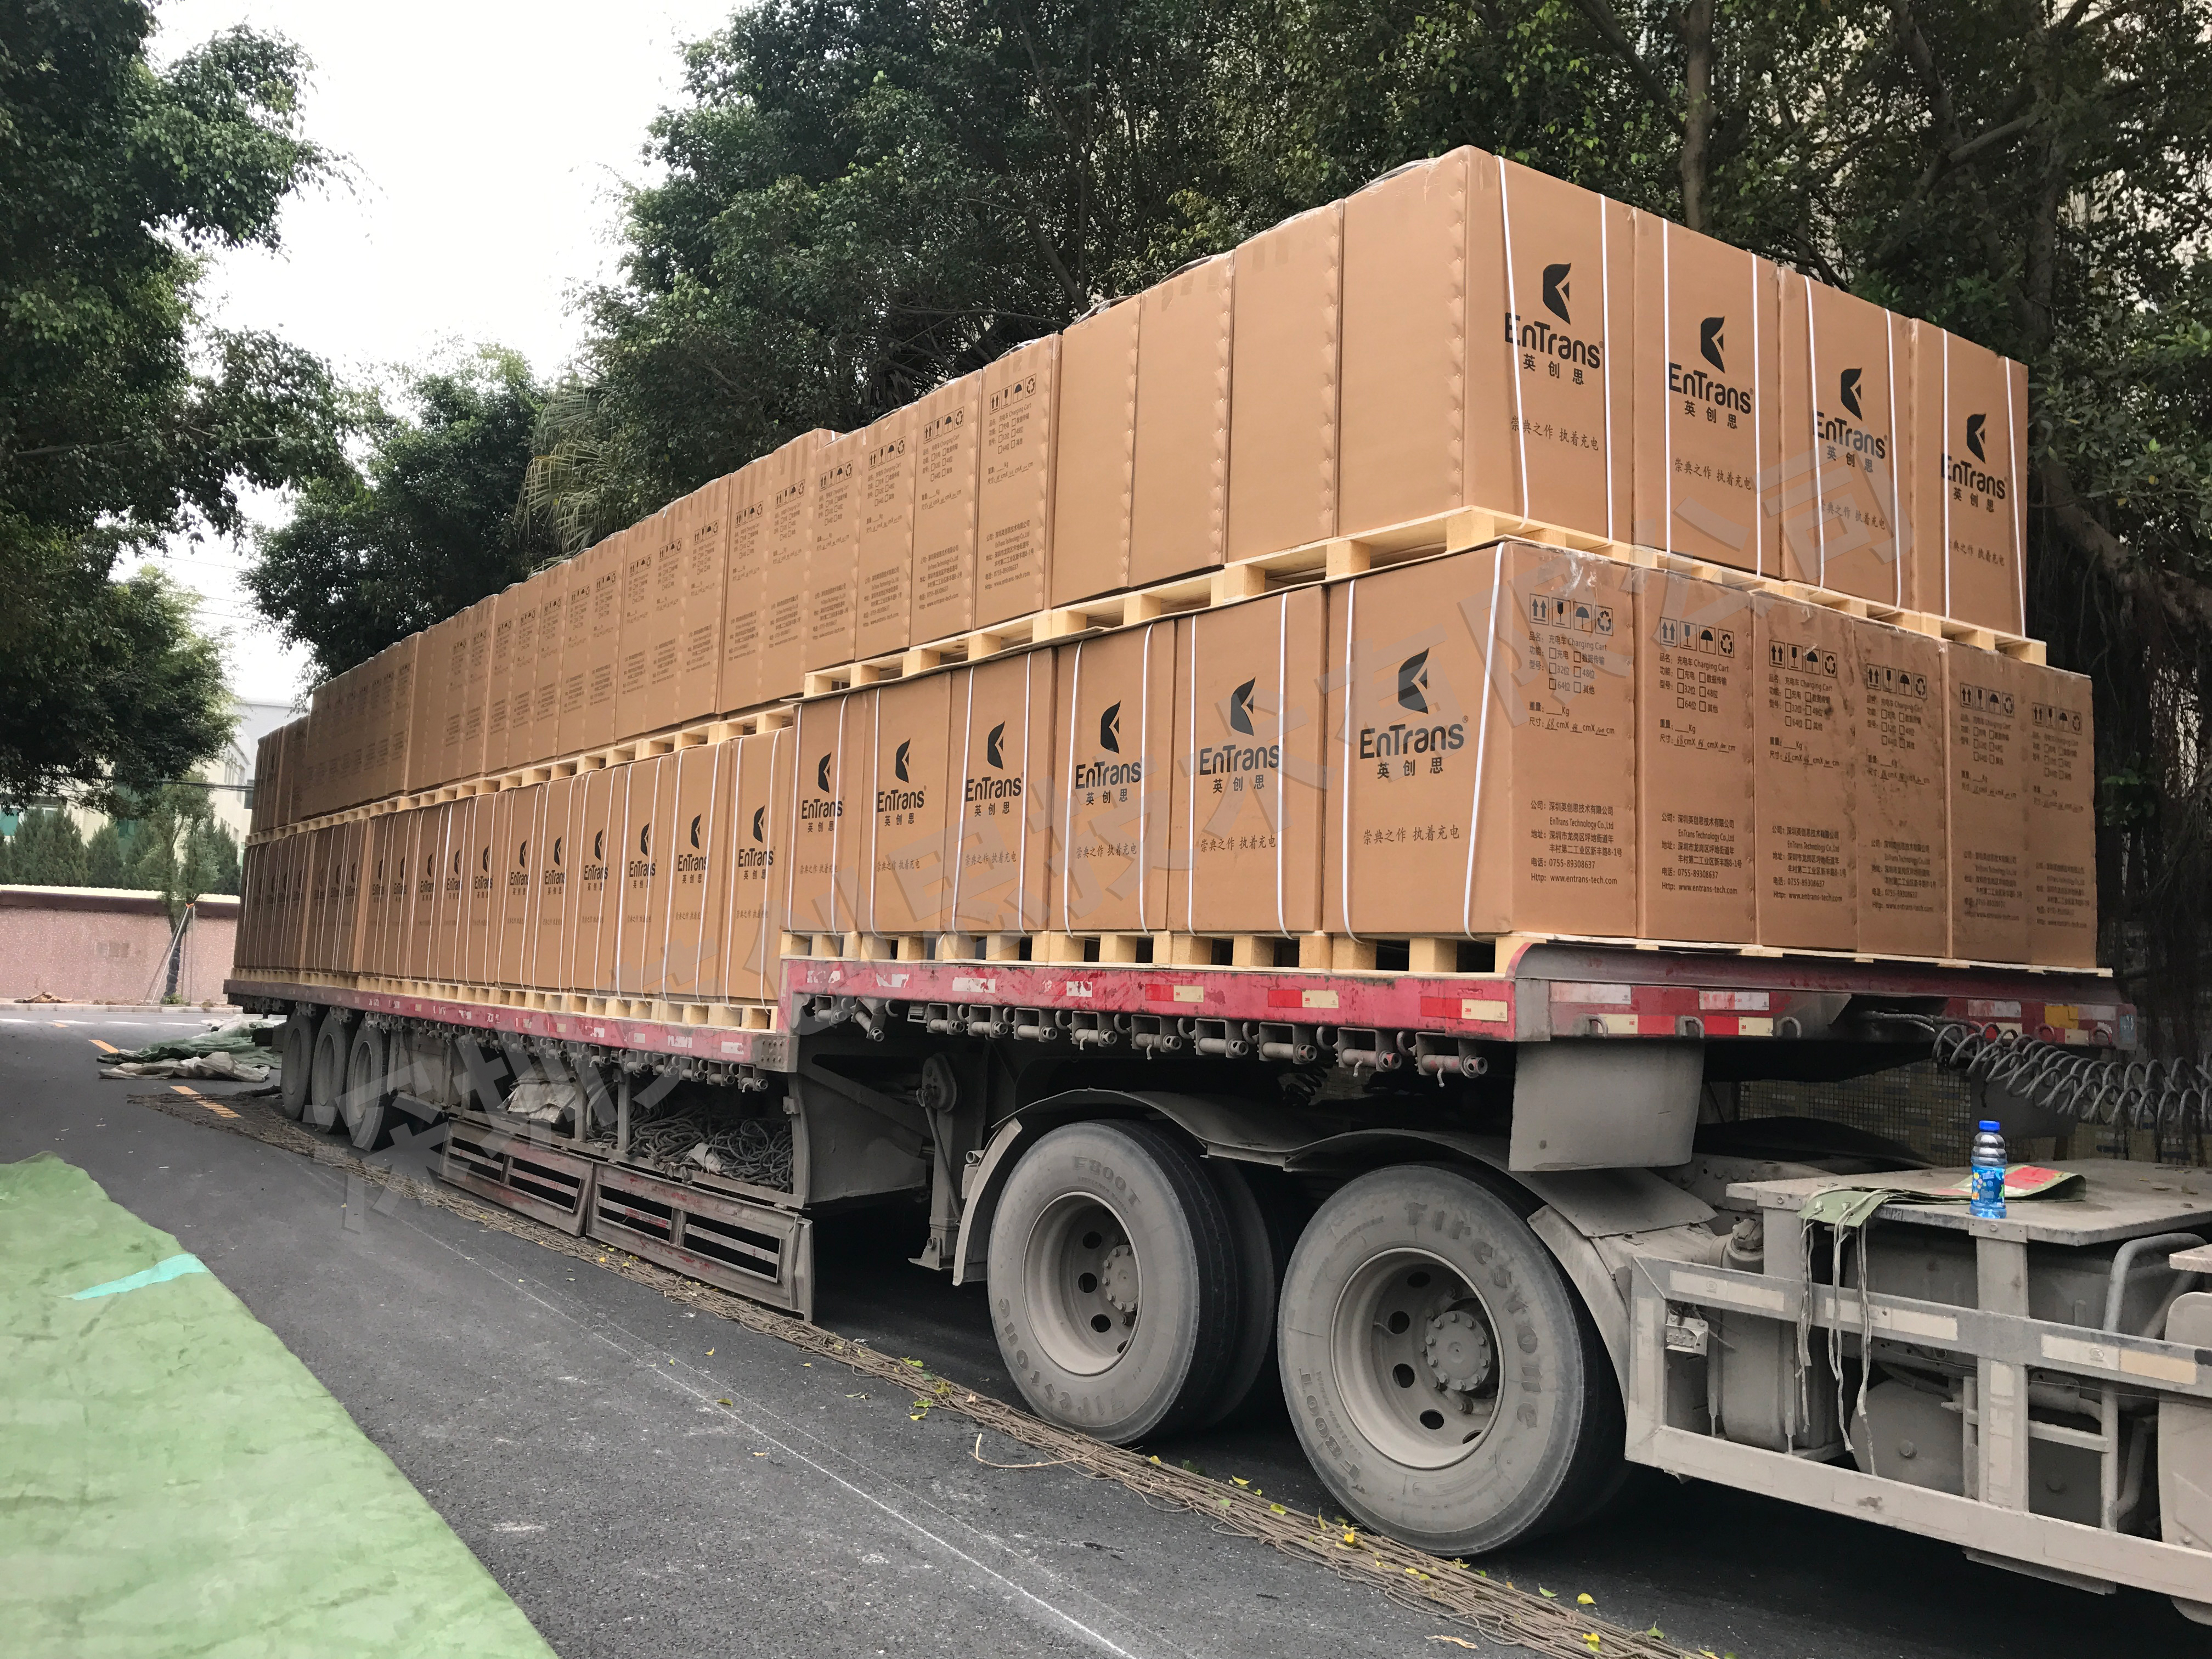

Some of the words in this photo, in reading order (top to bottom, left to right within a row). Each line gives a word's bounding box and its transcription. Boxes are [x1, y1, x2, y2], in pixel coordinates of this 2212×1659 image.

[1505, 312, 1600, 369] EnTrans
[1523, 353, 1584, 385] 英创思
[1669, 362, 1751, 414] EnTrans
[1684, 400, 1737, 429] 英创思
[1559, 428, 1598, 450] 执着充电
[1813, 411, 1885, 459] EnTrans
[1827, 445, 1873, 472] 英创思
[1941, 453, 2005, 499] EnTrans
[1568, 637, 1594, 651] Charging
[1595, 642, 1607, 651] Cart
[1694, 659, 1717, 672] Charging
[1718, 663, 1729, 672] Cart
[1360, 724, 1464, 759] EnTrans
[1200, 744, 1279, 775] EnTrans
[1377, 757, 1443, 779] 英创思
[1075, 761, 1141, 789] EnTrans
[1213, 775, 1265, 794] 英创思
[966, 776, 1022, 802] EnTrans
[1086, 788, 1127, 805] 英创思
[802, 799, 843, 819] EnTrans
[877, 789, 924, 812] EnTrans
[974, 802, 1009, 817] 英创思
[884, 812, 914, 826] 英创思
[1550, 817, 1568, 826] EnTrans
[1570, 819, 1596, 830] Technology
[1239, 834, 1276, 849] 执着充电
[1413, 825, 1459, 841] 执着充电
[1678, 829, 1695, 838] EnTrans
[1696, 831, 1719, 842] Technology
[738, 848, 774, 867] EnTrans
[1549, 859, 1595, 868] 0755-89308637
[1550, 875, 1617, 884] www.entrans-tech.com
[1678, 868, 1718, 879] 0755-89308637
[1679, 884, 1737, 894] www.entrans-tech.com
